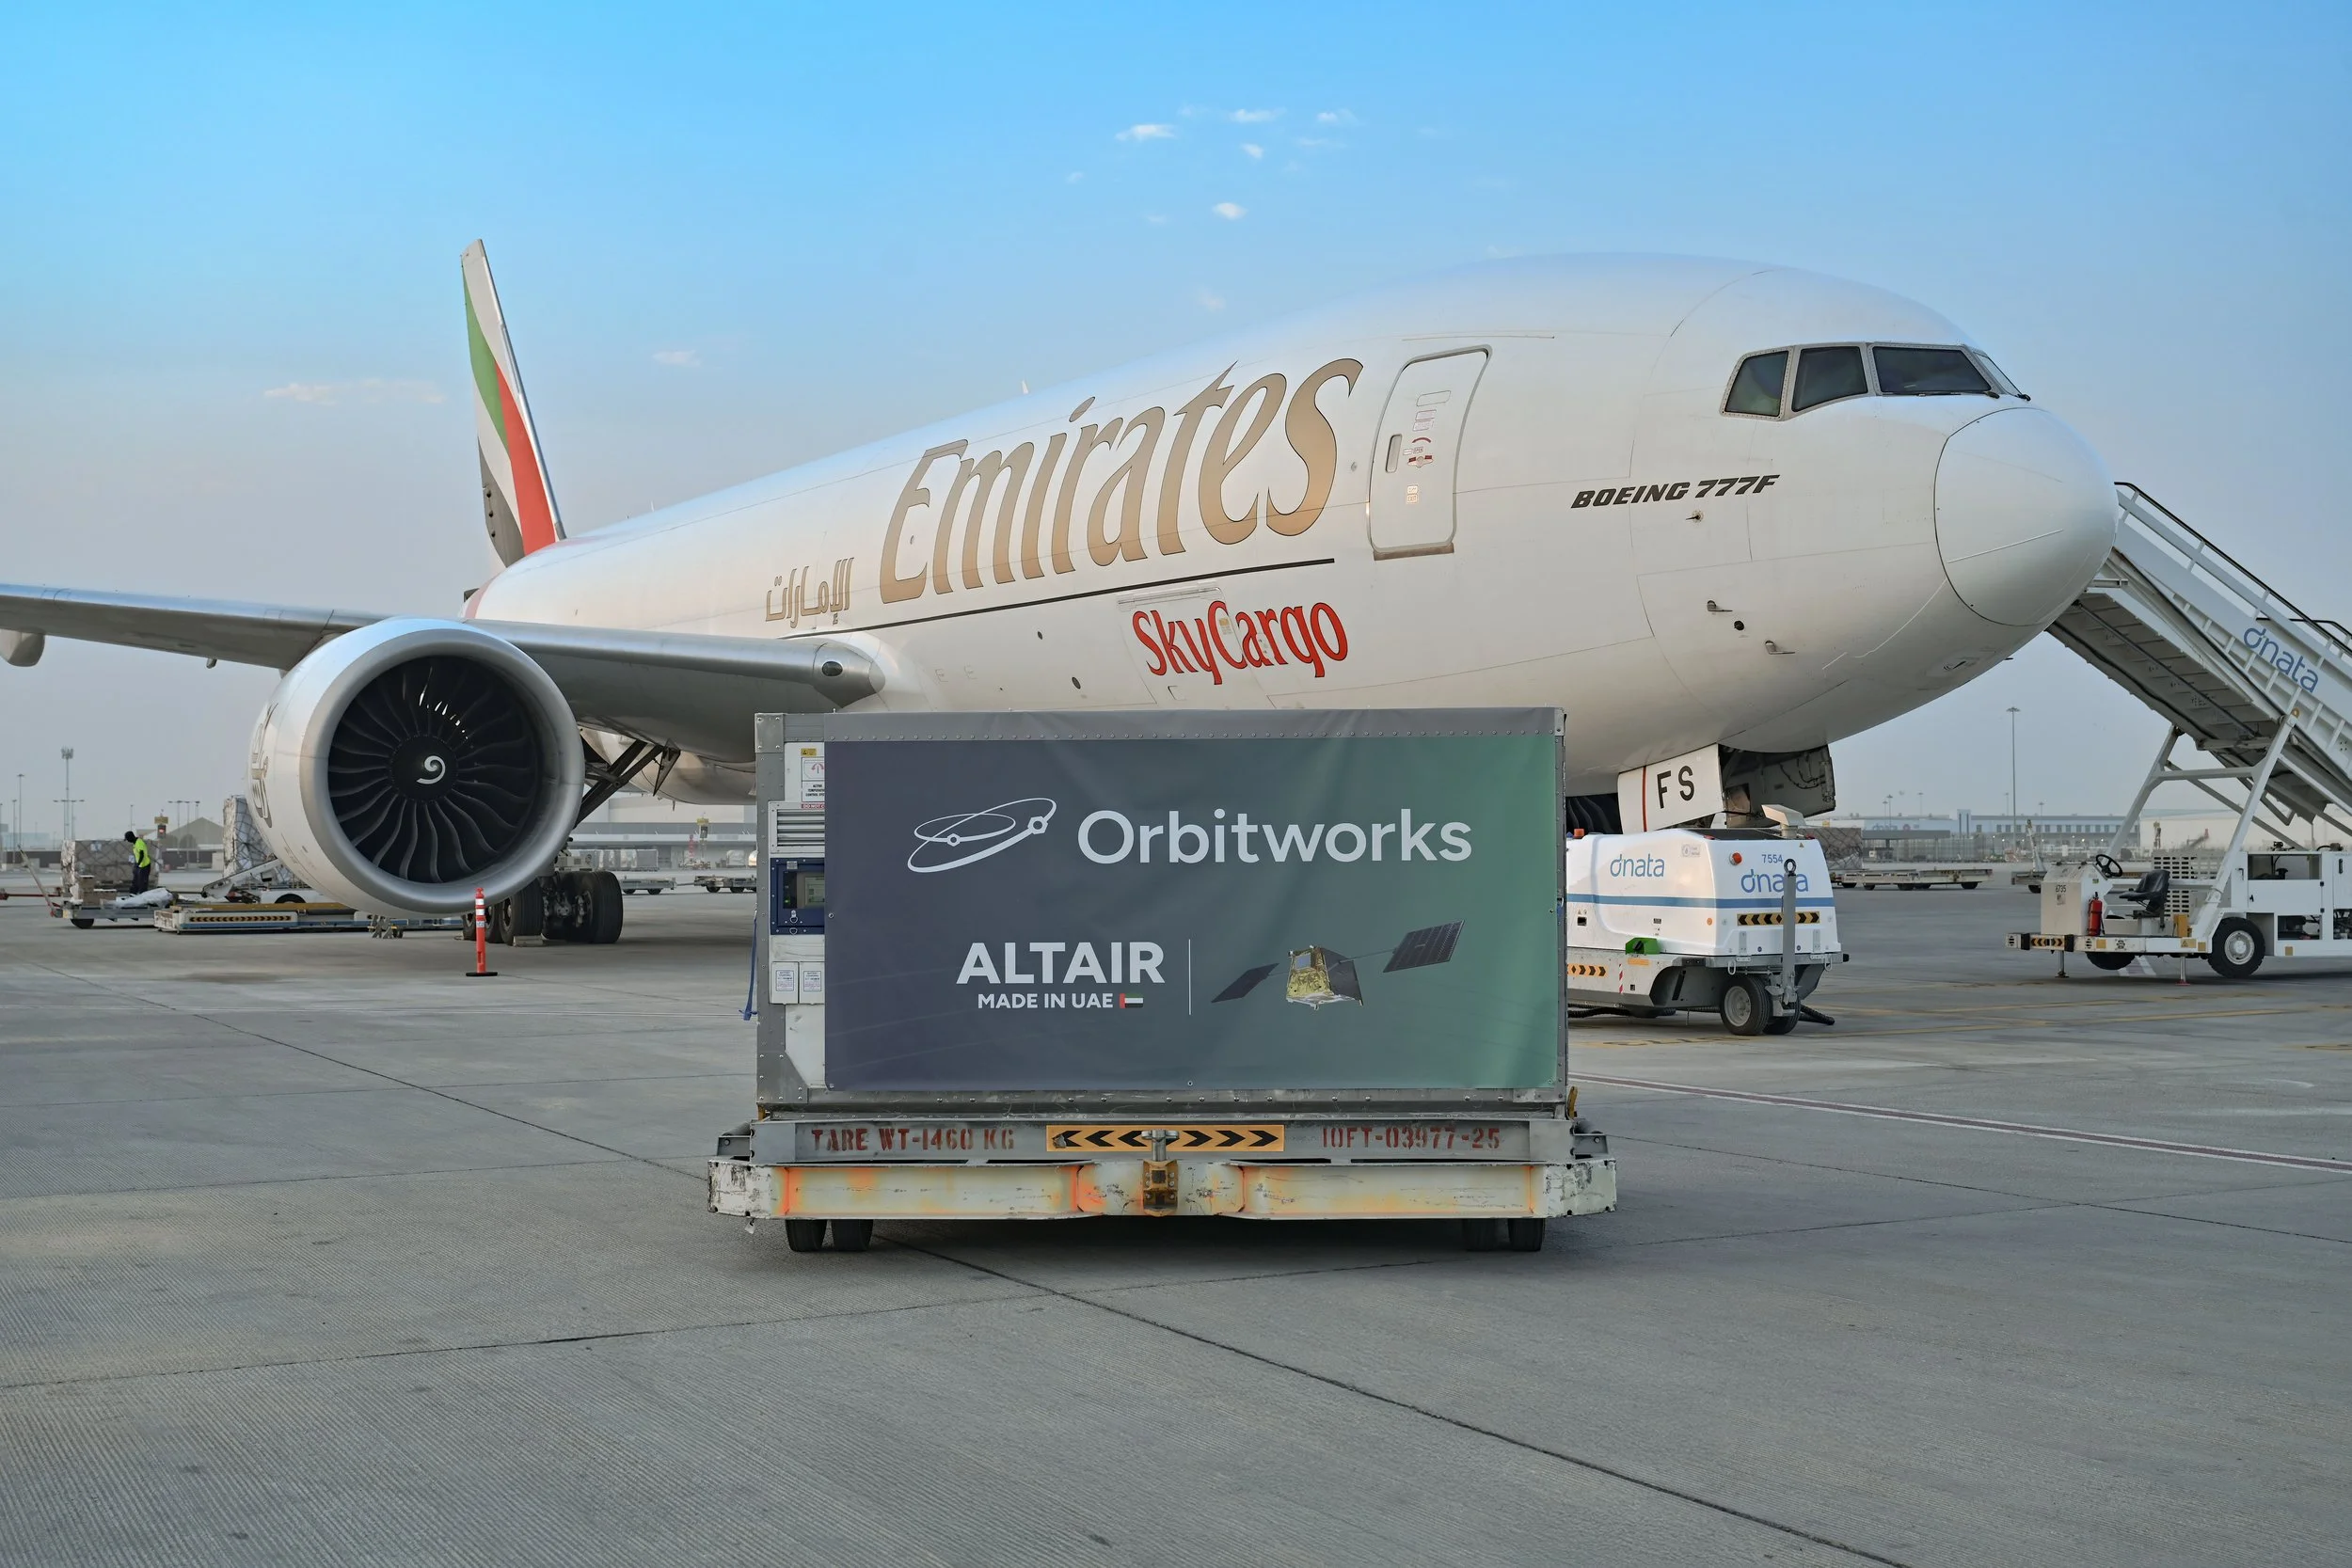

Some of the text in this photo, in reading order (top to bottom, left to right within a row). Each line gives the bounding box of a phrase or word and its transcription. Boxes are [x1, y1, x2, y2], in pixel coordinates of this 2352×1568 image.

[880, 358, 1364, 604] Emirates
[1570, 474, 1781, 509] BOEING 777F
[765, 557, 854, 629] الإمارات
[1132, 600, 1349, 685] SkyCargo
[2243, 627, 2319, 693] dnata
[1656, 765, 1695, 810] FS
[1077, 808, 1473, 864] Orbitworks
[1610, 853, 1665, 878] dnata
[1761, 854, 1784, 864] 7554
[1740, 868, 1809, 894] dnaa
[956, 942, 1166, 985] ALTAIR
[977, 992, 1114, 1009] MADE IN UAE
[811, 1128, 1015, 1152] TARE WT-1460 KG
